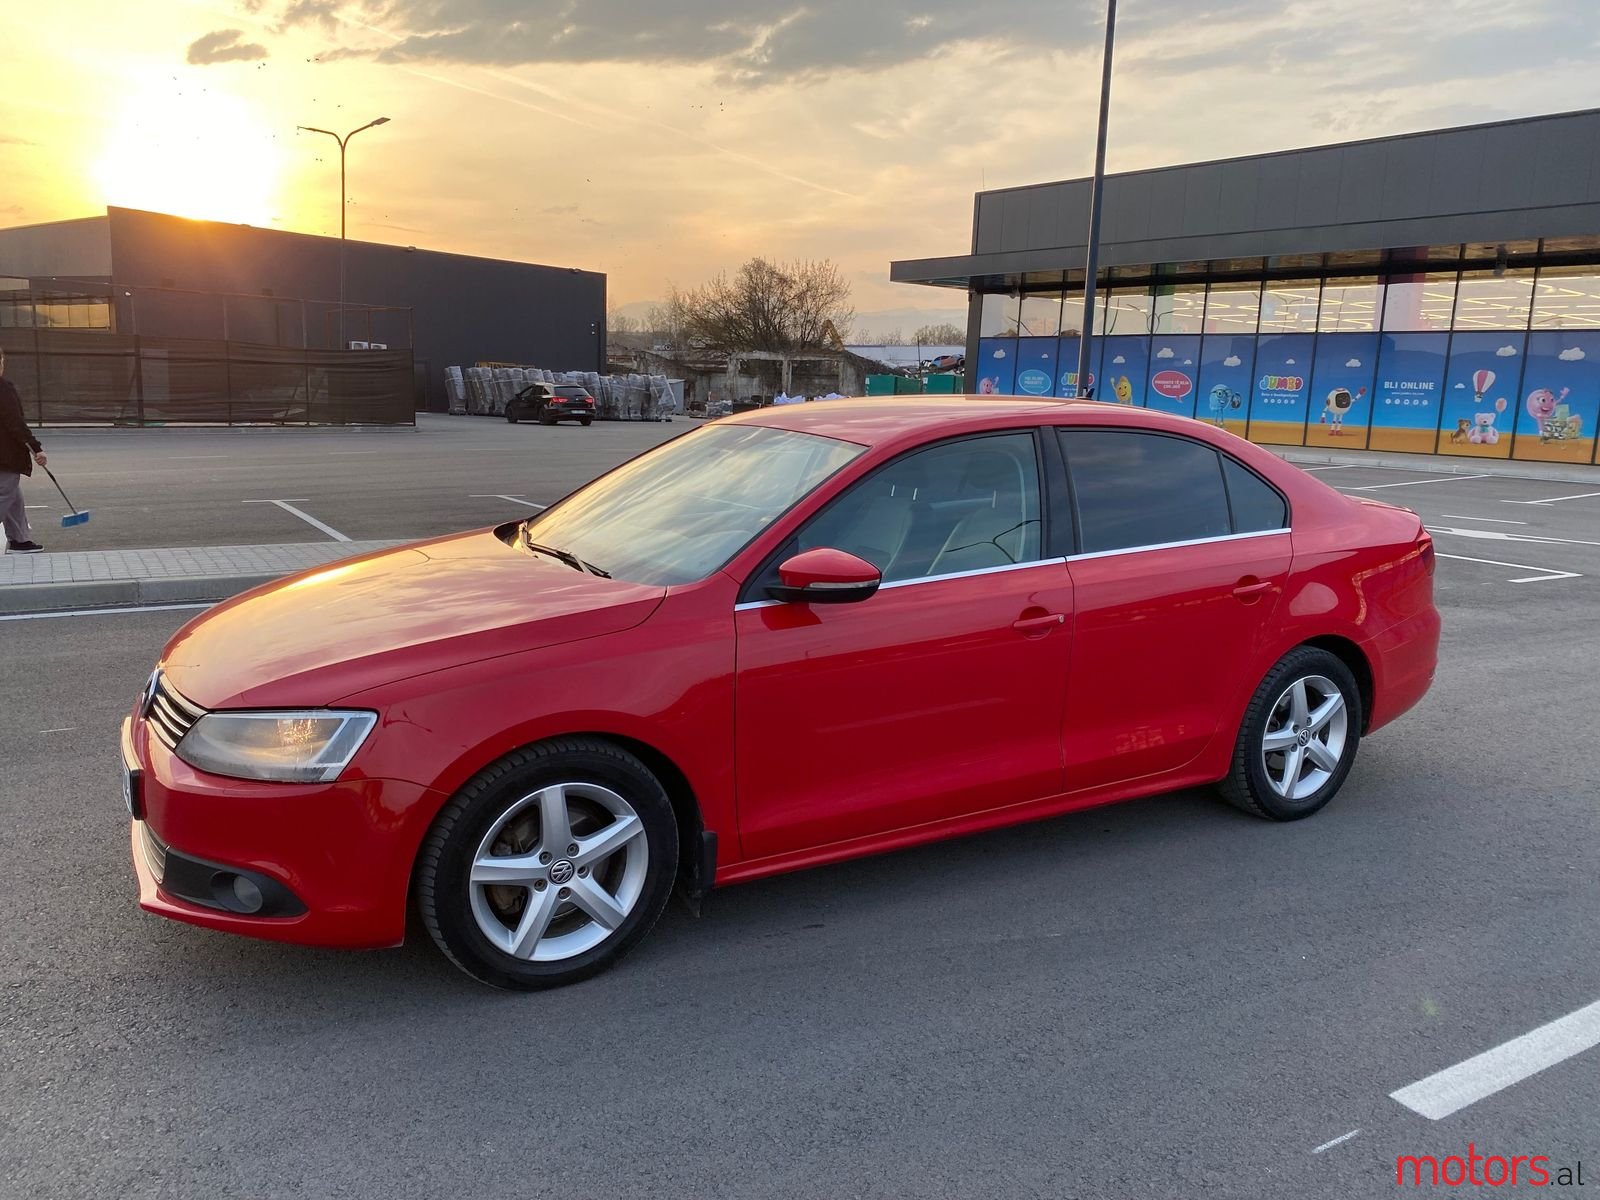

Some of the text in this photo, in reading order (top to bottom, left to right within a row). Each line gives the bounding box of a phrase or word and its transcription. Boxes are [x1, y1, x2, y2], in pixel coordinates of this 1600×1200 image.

[1061, 372, 1095, 386] JUO
[1260, 375, 1303, 391] JUMBO
[1384, 381, 1435, 390] BLI ONLINE
